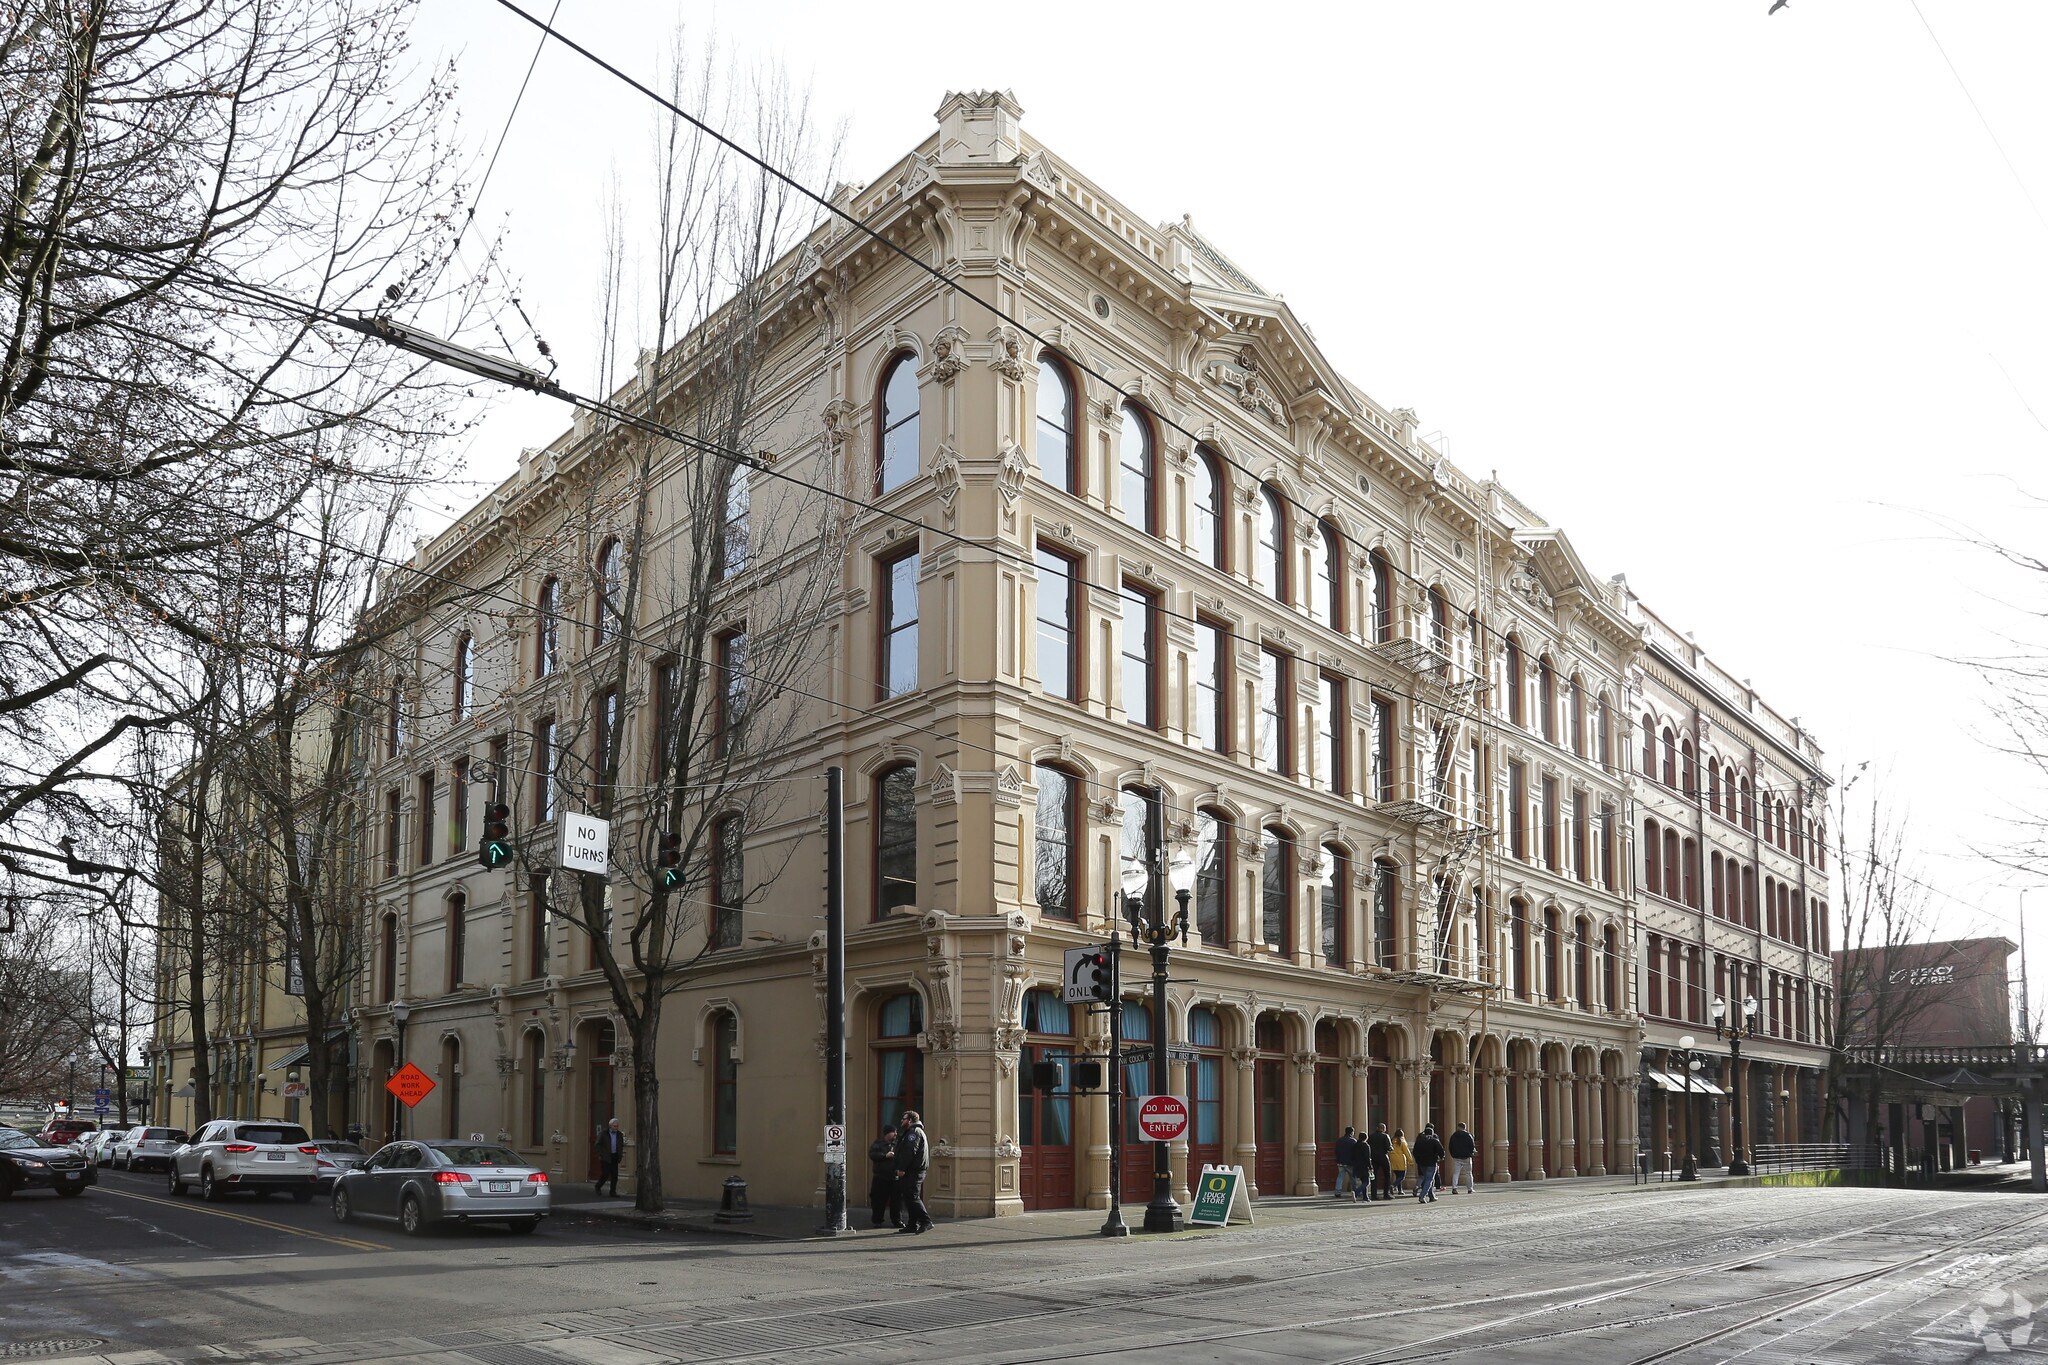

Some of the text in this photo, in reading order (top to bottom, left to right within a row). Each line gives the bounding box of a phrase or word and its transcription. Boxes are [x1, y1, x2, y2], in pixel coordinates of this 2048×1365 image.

[761, 451, 776, 463] 10A
[578, 826, 596, 841] NO
[567, 844, 604, 863] TURNS
[1128, 1054, 1145, 1064] COUCH
[1178, 1052, 1190, 1061] FIRST
[1192, 1053, 1200, 1061] AVE
[99, 1098, 106, 1107] 5
[1146, 1104, 1180, 1112] DO NOT
[1149, 1124, 1178, 1132] ENTER
